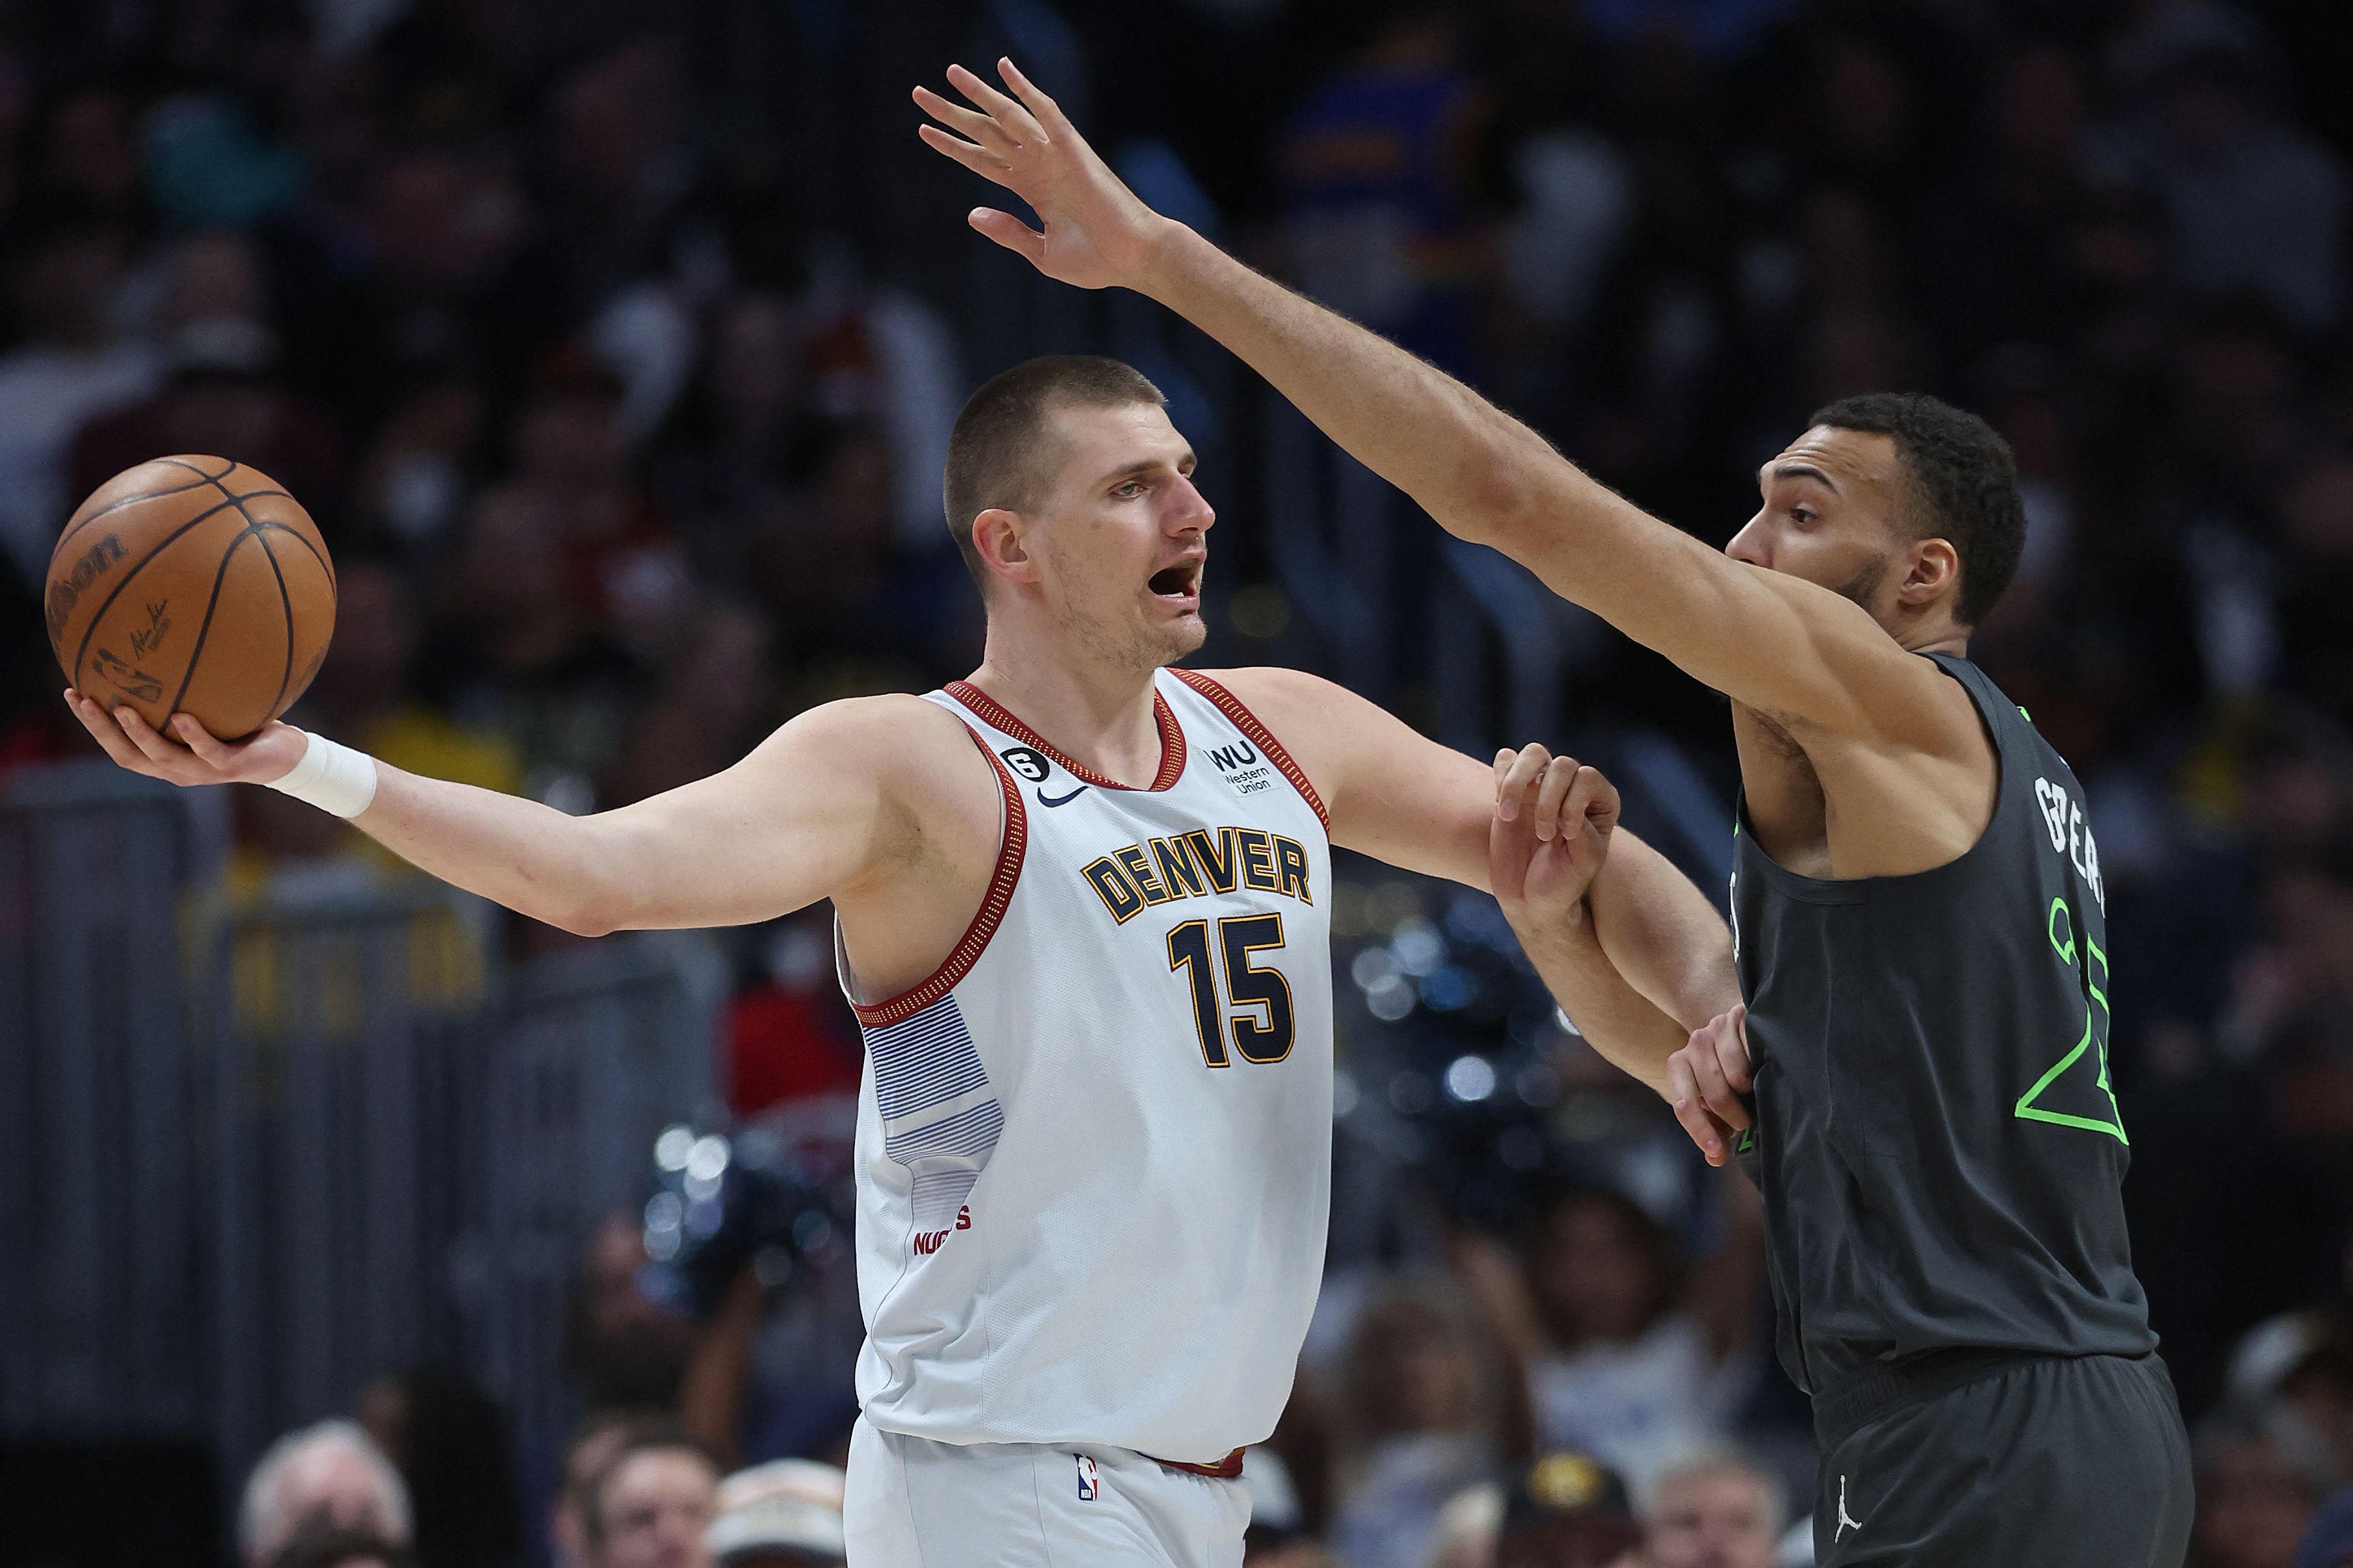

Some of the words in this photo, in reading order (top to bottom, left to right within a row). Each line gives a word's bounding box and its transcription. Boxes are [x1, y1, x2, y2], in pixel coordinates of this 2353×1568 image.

[1006, 752, 1042, 778] 6
[1202, 740, 1256, 772] WU
[1221, 767, 1270, 785] Western
[1236, 780, 1271, 794] Union
[1080, 826, 1313, 926] DENVER
[1166, 912, 1295, 1069] 15
[913, 1205, 971, 1256] NUGS
[1080, 1489, 1091, 1499] NBA
